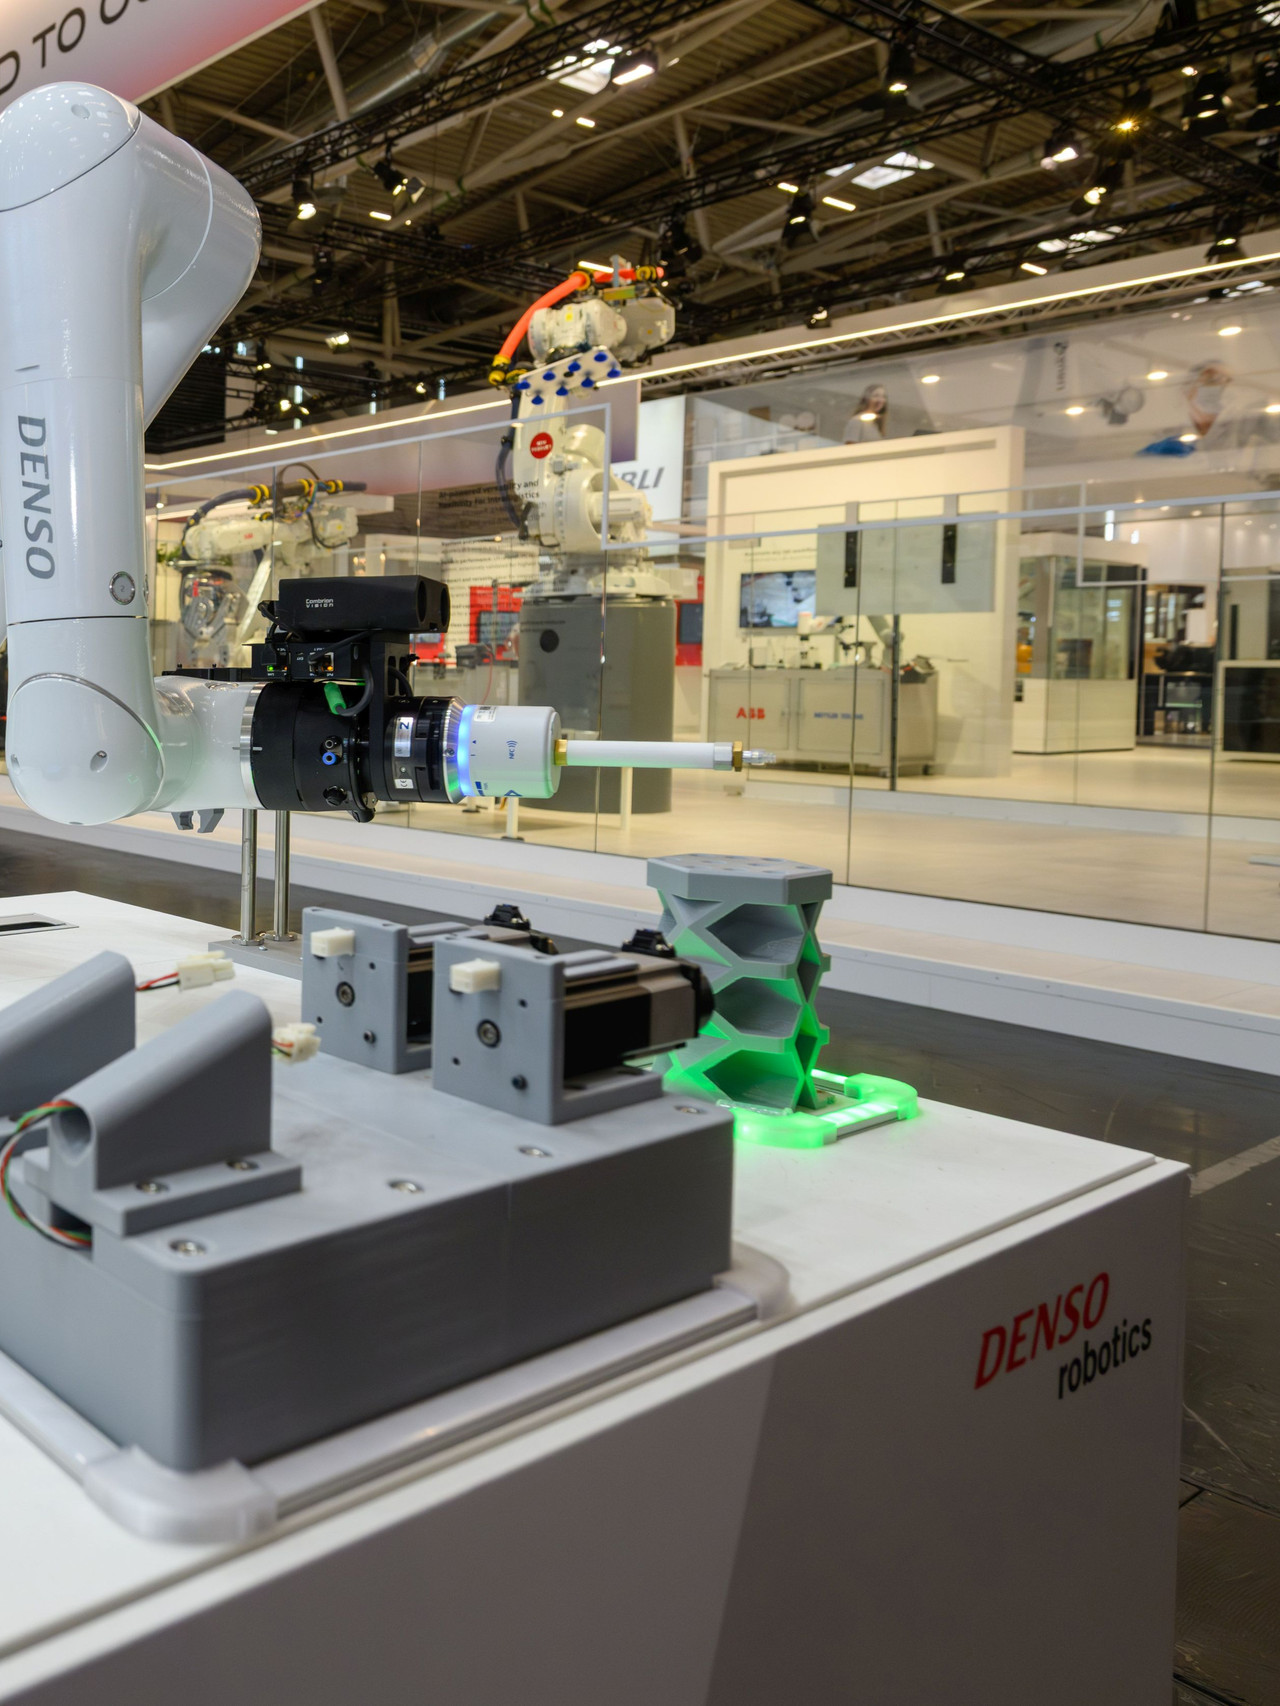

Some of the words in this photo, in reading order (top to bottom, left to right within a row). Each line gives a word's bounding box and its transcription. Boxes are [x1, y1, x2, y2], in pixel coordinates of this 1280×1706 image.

[32, 7, 86, 68] TO
[100, 0, 151, 25] O
[18, 415, 55, 579] DENSO
[524, 479, 539, 488] and
[736, 707, 766, 720] ABB
[974, 1272, 1110, 1390] DENSO
[1058, 1318, 1152, 1400] robotics
